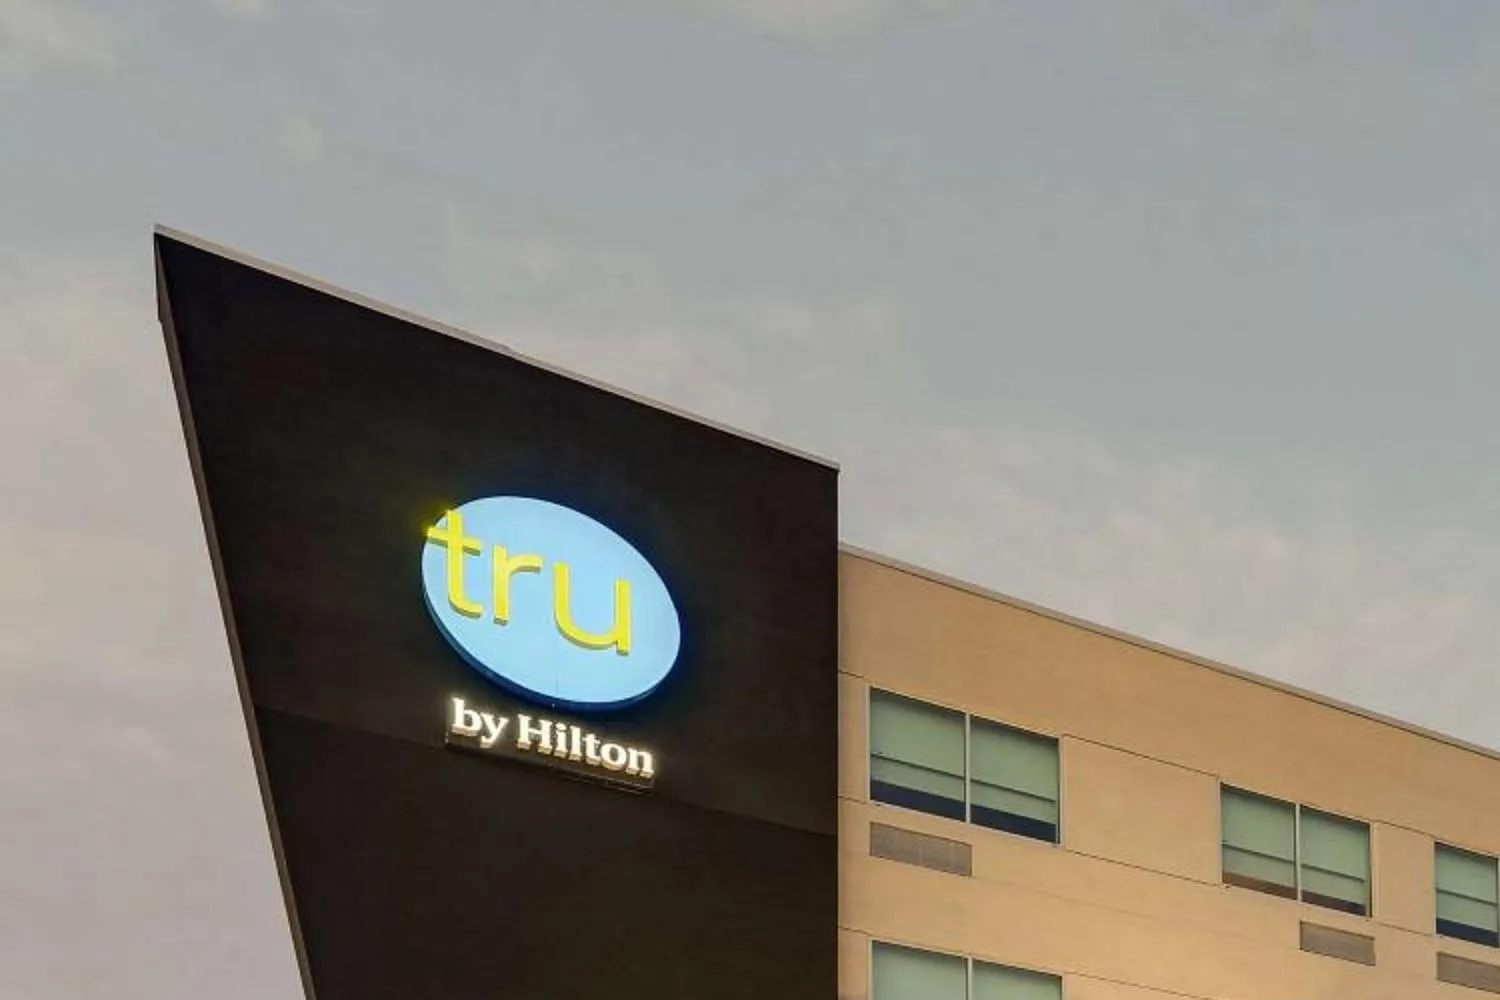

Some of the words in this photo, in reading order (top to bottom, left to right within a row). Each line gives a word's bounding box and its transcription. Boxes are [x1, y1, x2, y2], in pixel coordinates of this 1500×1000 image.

[427, 510, 632, 656] tru
[452, 697, 509, 748] by
[516, 713, 656, 778] Hilton
